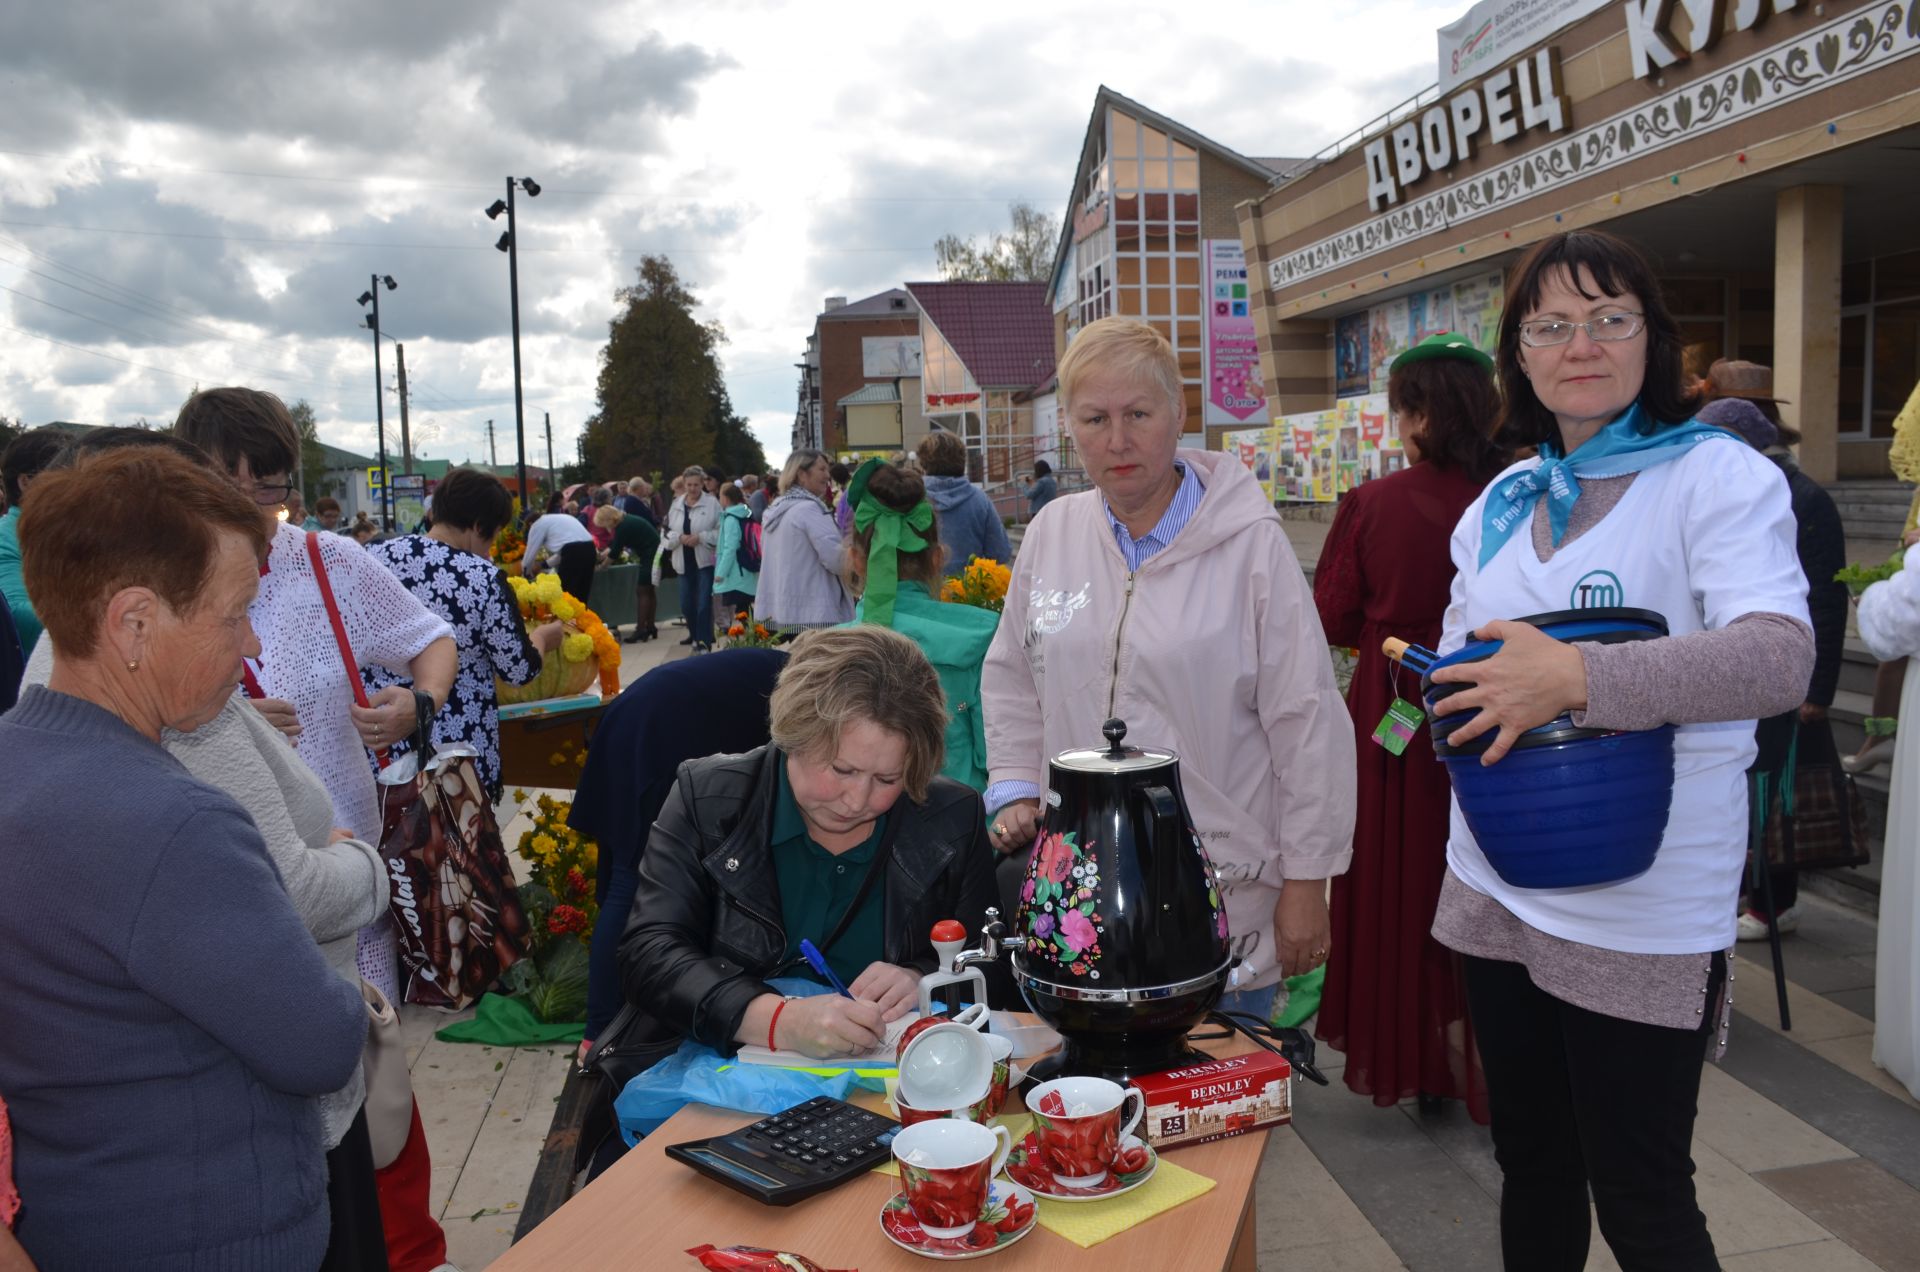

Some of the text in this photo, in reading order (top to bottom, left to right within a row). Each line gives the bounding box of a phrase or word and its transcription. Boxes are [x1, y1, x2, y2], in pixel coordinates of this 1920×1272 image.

[1451, 48, 1459, 75] 8
[1364, 46, 1563, 212] ДВОРЕЦ
[1166, 1057, 1248, 1079] BERNLEY
[1190, 1077, 1252, 1100] BERNLEY
[1166, 1117, 1181, 1130] 25
[1200, 1128, 1245, 1143] EARL GREY
